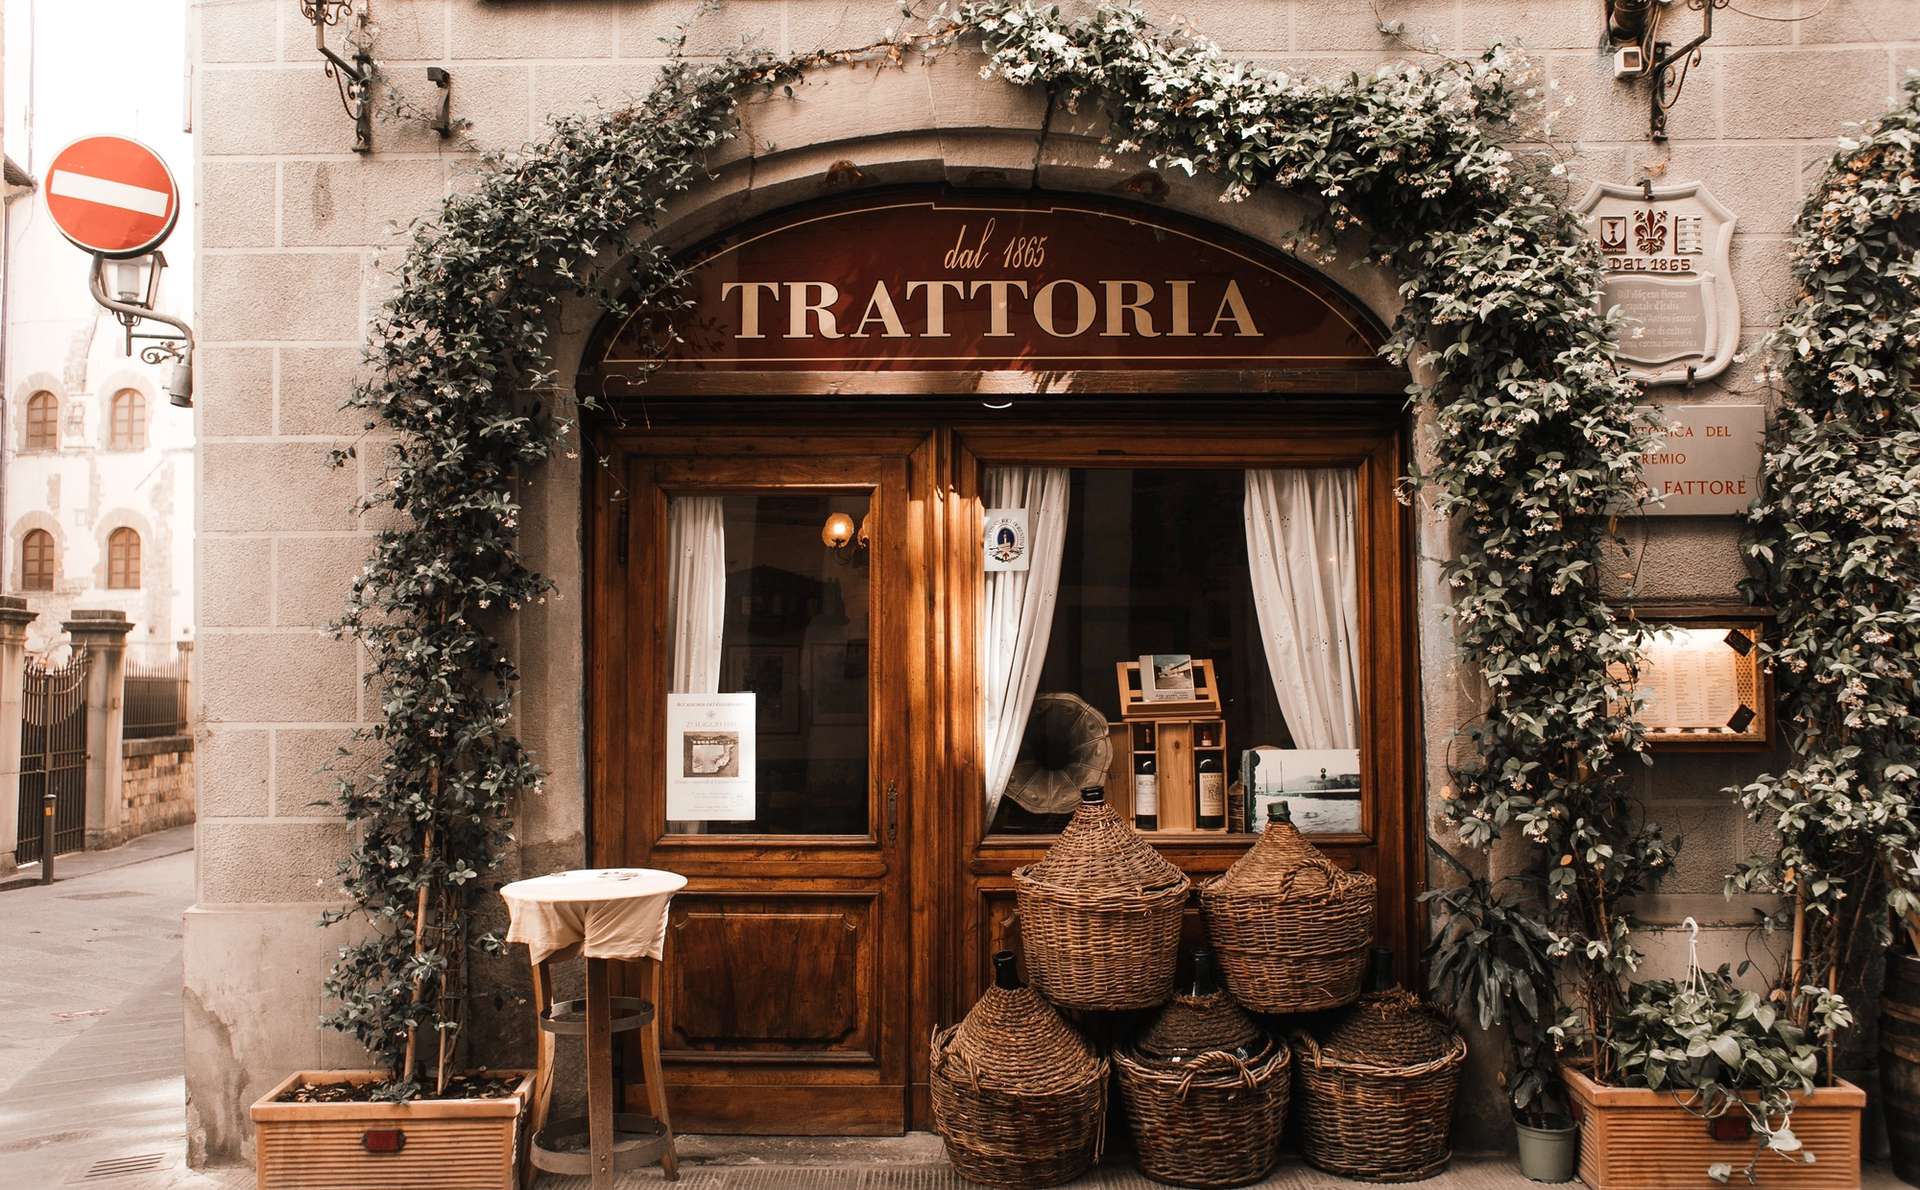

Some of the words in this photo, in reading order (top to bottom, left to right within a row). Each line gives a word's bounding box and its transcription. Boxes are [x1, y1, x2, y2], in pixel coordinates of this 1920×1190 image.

[944, 217, 996, 270] dal
[1003, 236, 1048, 268] 1865
[1650, 258, 1691, 271] 1865
[721, 279, 1265, 339] TRATTORIA
[1705, 425, 1732, 438] DEL
[1637, 453, 1687, 465] REMIO
[1663, 480, 1747, 495] FATTORE
